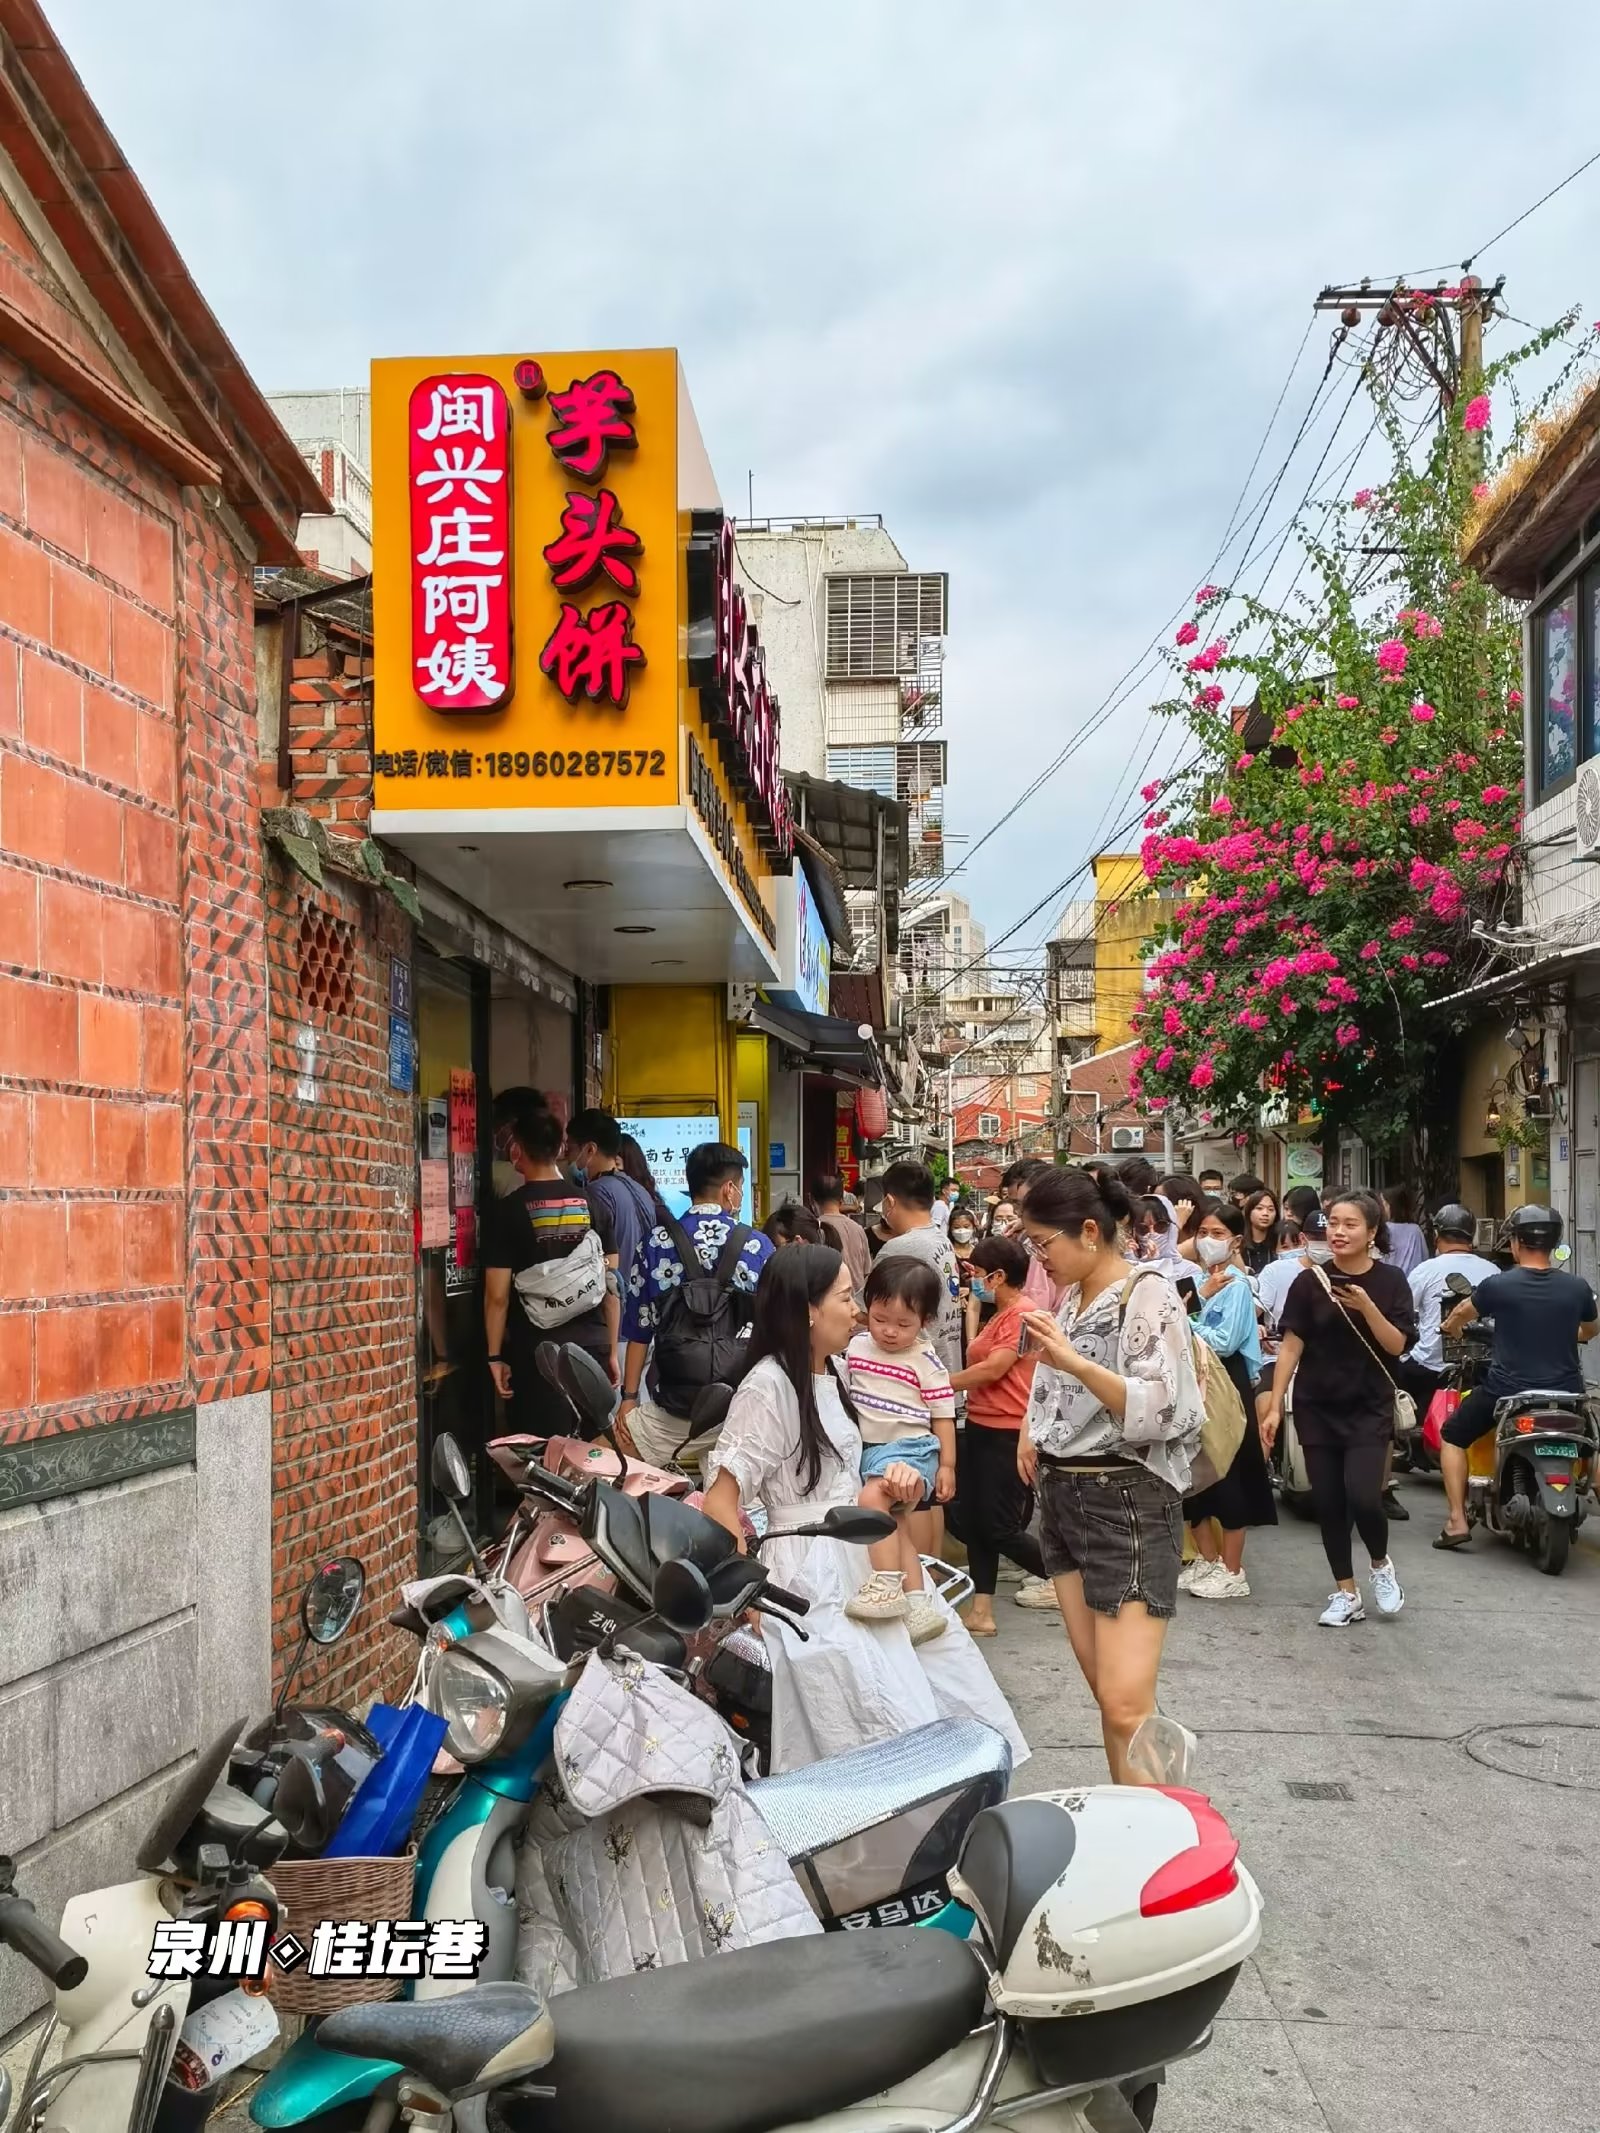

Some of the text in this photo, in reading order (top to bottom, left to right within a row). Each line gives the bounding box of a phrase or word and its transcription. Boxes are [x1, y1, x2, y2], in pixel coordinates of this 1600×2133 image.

[416, 384, 506, 700] 闽兴庄阿姨
[540, 369, 645, 706] 芋头饼
[374, 749, 666, 778] 电话/微信:18960287572
[1317, 1213, 1328, 1228] LA
[577, 1278, 597, 1299] AIR
[840, 1889, 945, 1931] 安马达
